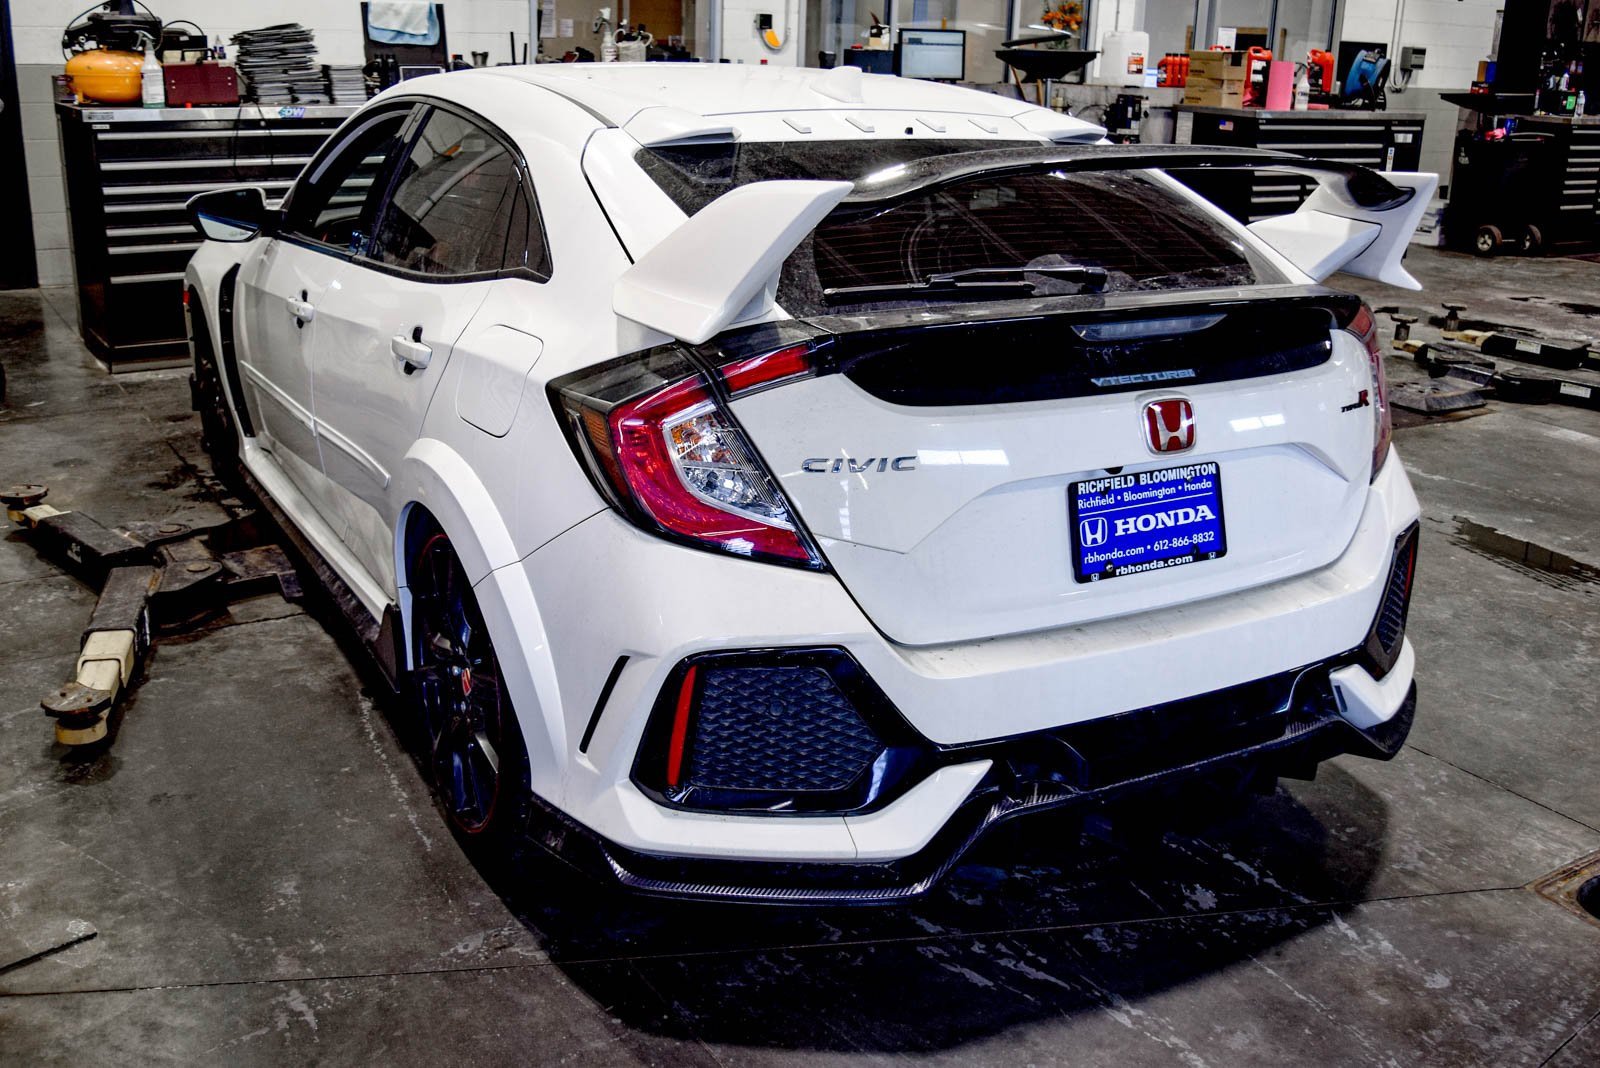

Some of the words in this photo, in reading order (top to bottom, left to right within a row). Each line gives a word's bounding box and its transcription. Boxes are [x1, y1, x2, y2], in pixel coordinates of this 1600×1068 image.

[801, 456, 917, 473] CIVIC
[1077, 476, 1135, 495] RICHFIELD
[1139, 463, 1217, 486] BLOOMINGTON
[1077, 494, 1115, 510] Richfield
[1123, 486, 1176, 503] Bloomington
[1184, 479, 1212, 492] Honda
[1114, 504, 1216, 537] HONDA
[1084, 546, 1145, 564] rbhonda.com
[1153, 531, 1215, 551] 612-866-8832
[1115, 555, 1193, 576] rbhonda.com
